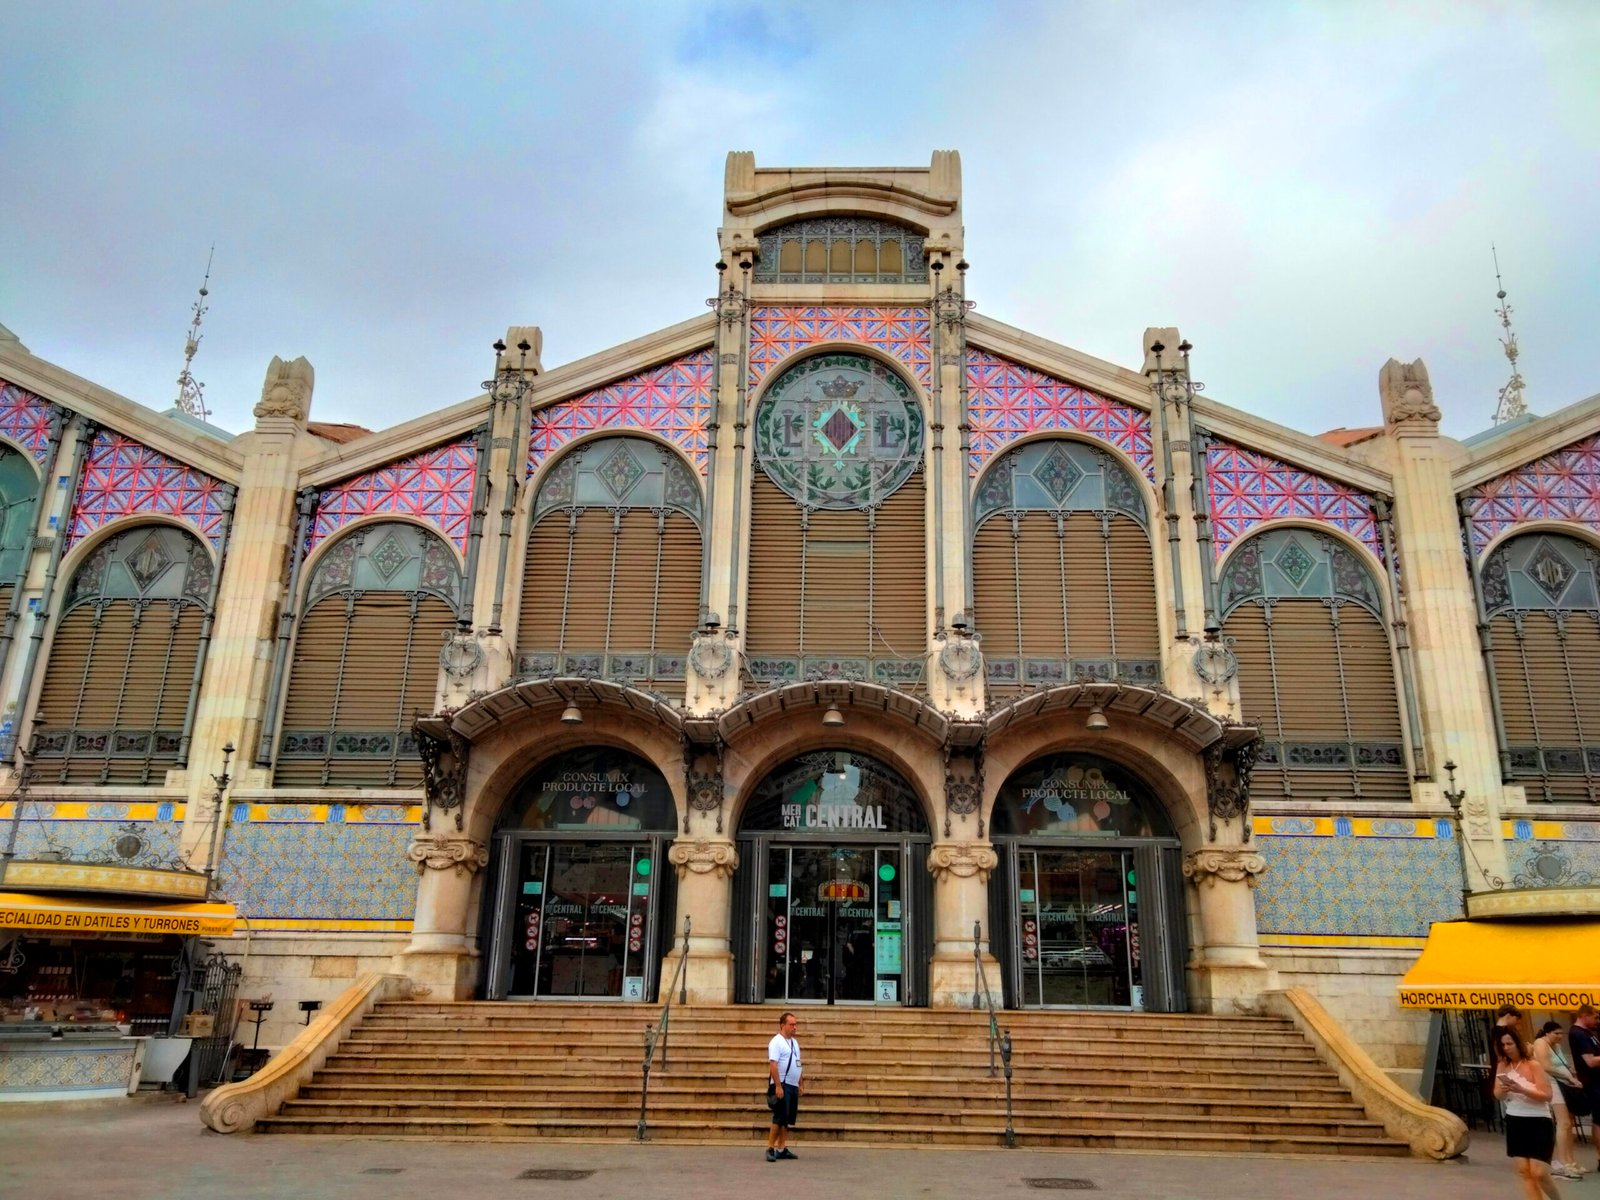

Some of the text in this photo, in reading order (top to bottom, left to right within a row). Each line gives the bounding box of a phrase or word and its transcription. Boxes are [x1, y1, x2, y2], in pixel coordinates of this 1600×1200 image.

[542, 782, 649, 793] PRODUCTE LOCAL
[1022, 788, 1131, 800] PRODUCTE LOCAL
[781, 804, 801, 816] MER
[784, 815, 801, 828] CAT
[805, 804, 887, 829] CENTRAL
[553, 904, 583, 914] CENTRAL
[795, 906, 825, 917] CENTRAL
[847, 907, 875, 918] CENTRA
[65, 914, 81, 927] EN
[84, 915, 130, 929] DATILES
[133, 917, 141, 928] Y
[143, 917, 200, 931] TURRONES
[1400, 992, 1467, 1005] HORCHATA
[1469, 992, 1534, 1006] CHURROS
